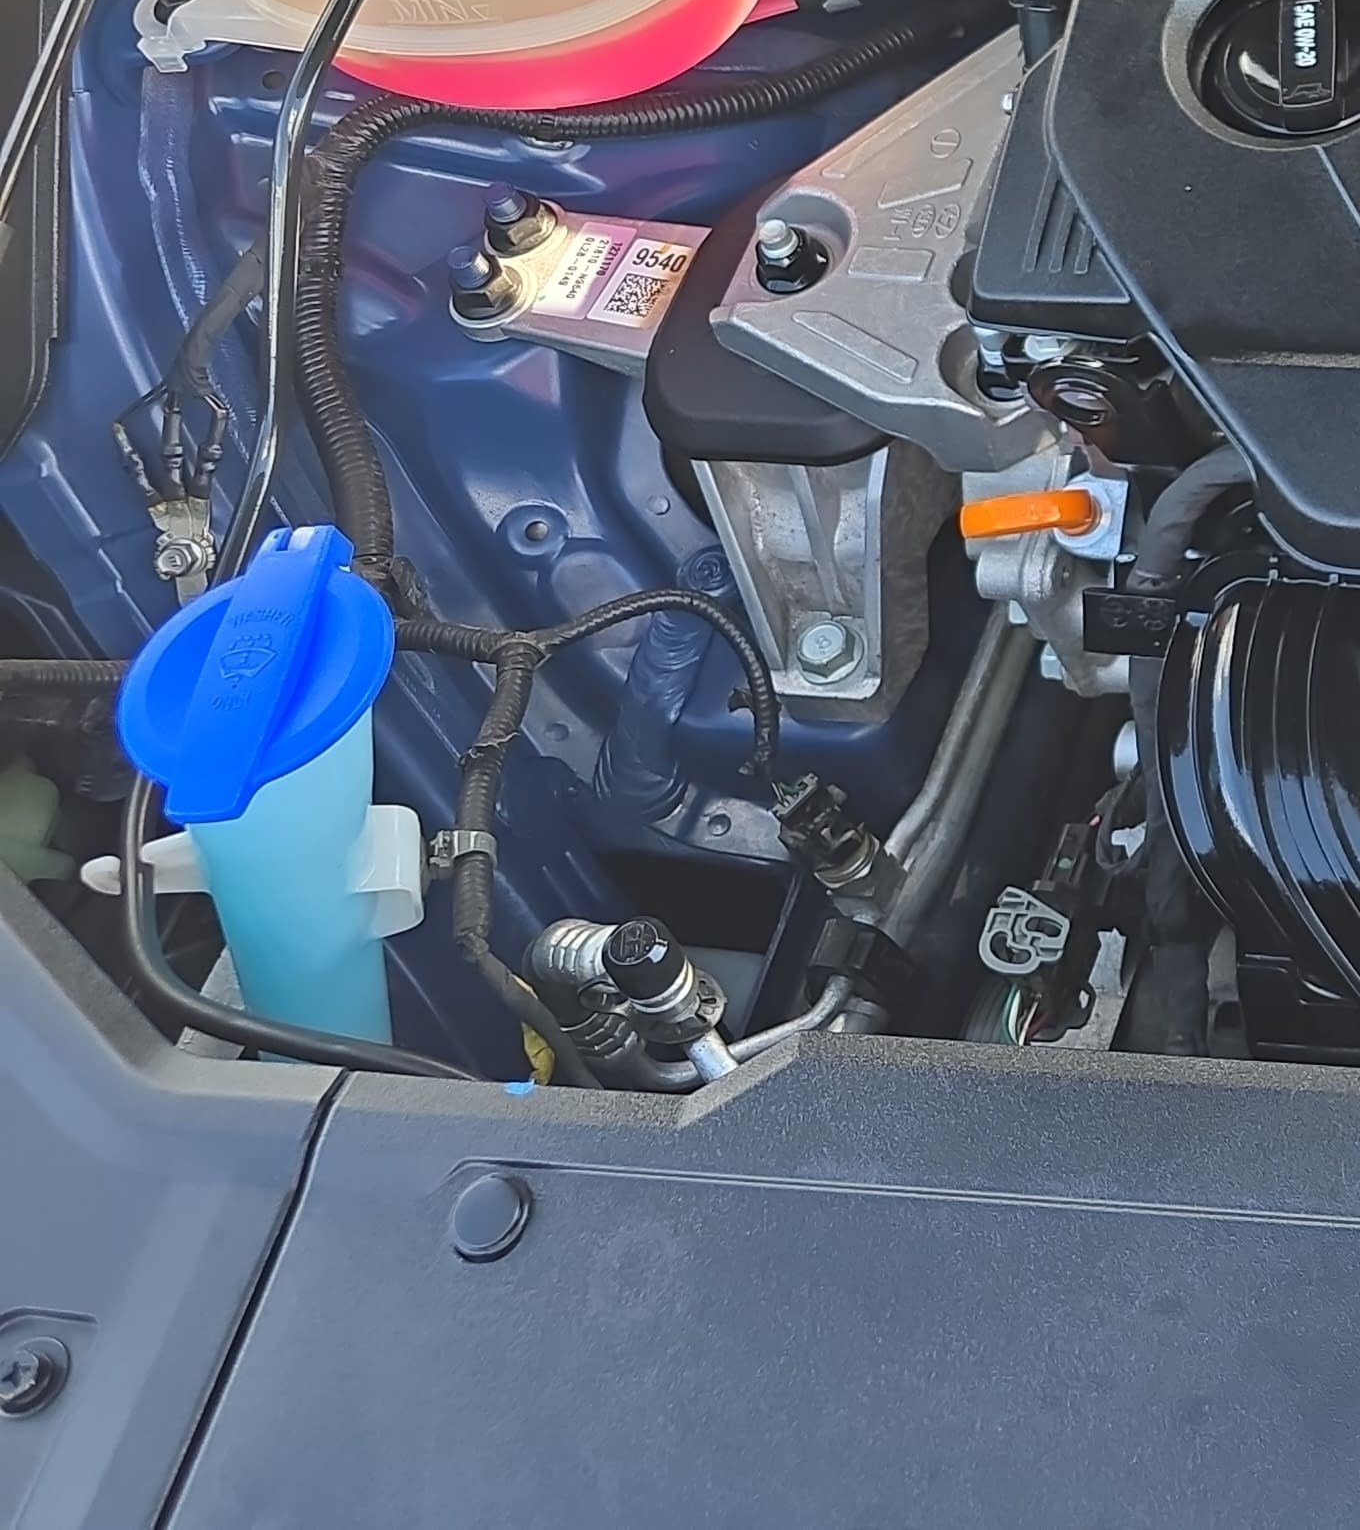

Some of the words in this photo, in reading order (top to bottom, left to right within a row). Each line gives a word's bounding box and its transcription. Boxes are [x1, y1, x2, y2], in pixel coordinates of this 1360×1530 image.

[1294, 3, 1314, 27] SAE
[1294, 28, 1315, 67] 0W-20
[632, 248, 688, 274] 9540
[211, 693, 252, 711] ONLY
